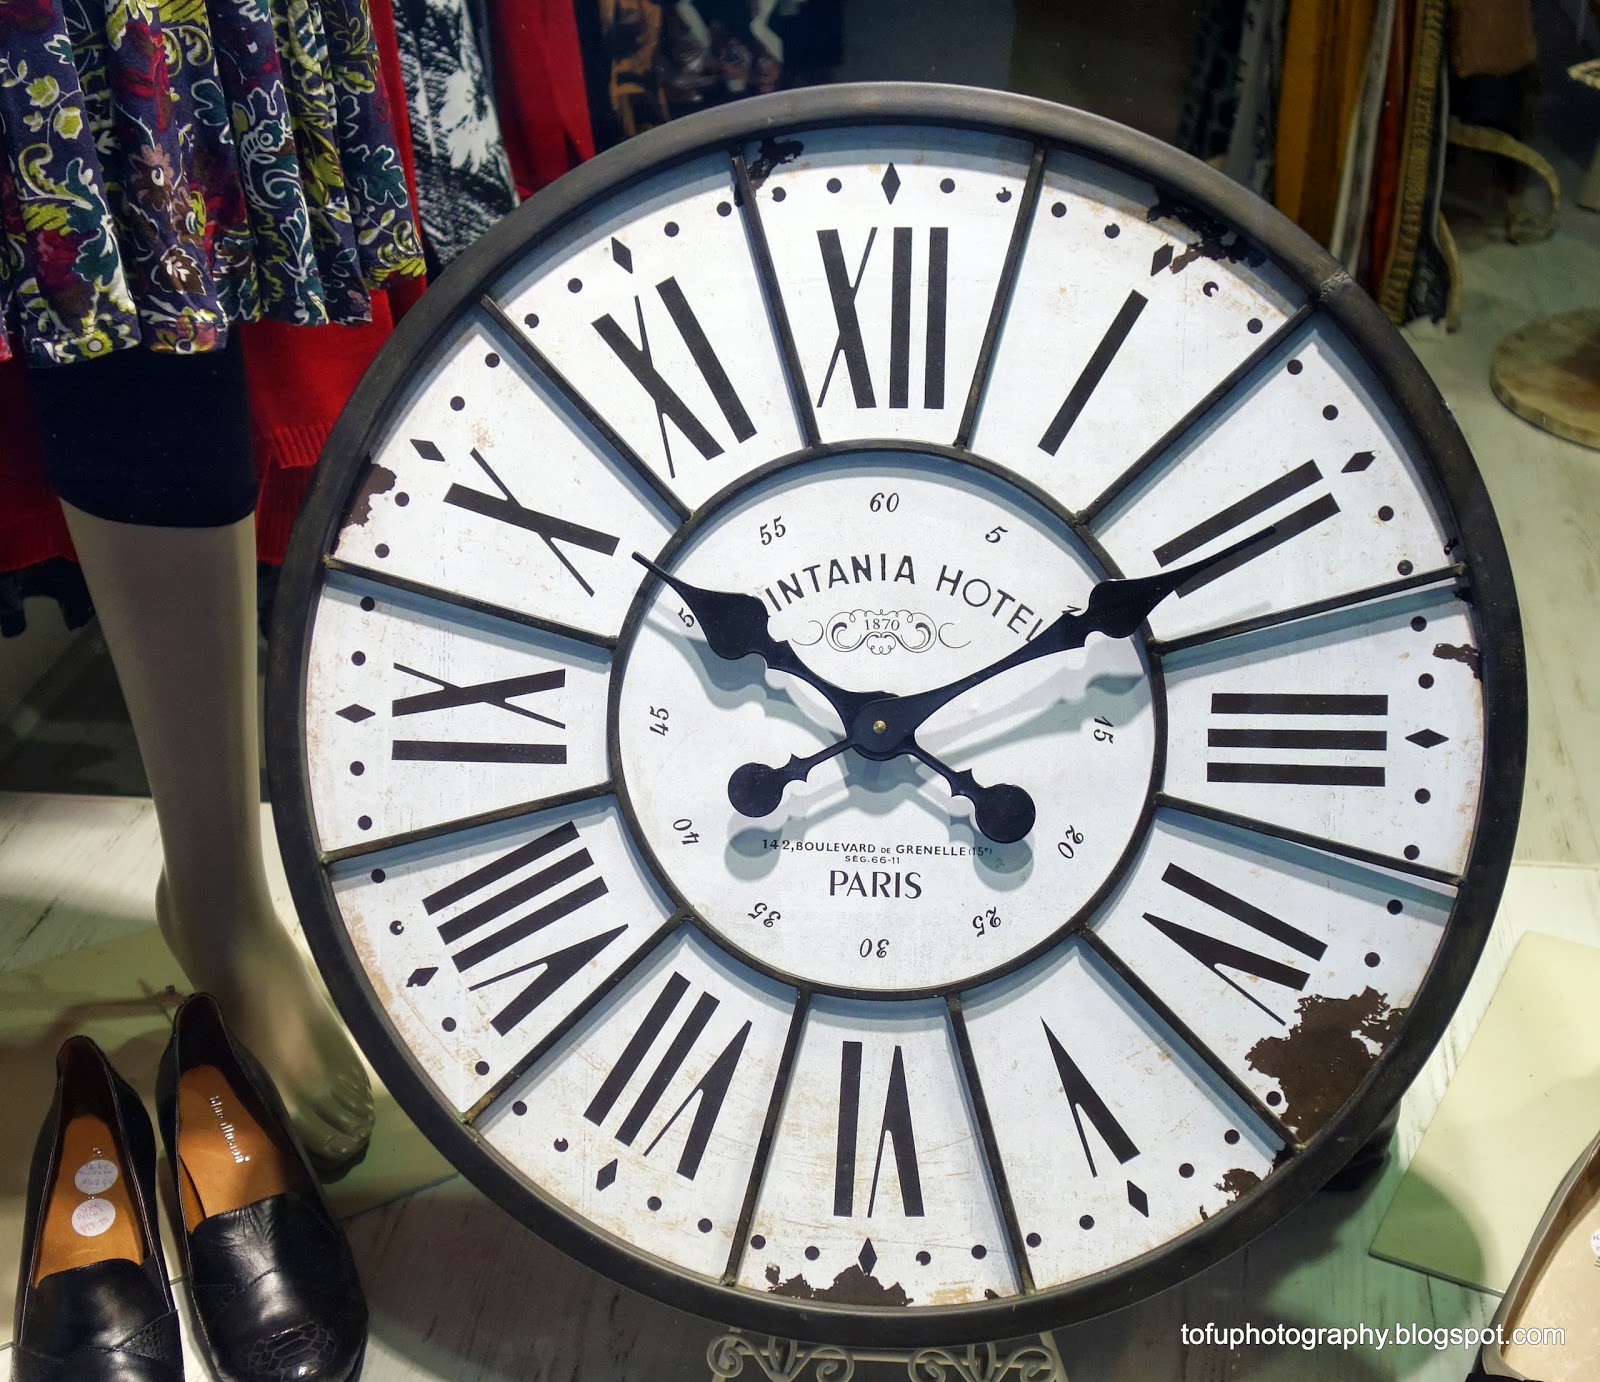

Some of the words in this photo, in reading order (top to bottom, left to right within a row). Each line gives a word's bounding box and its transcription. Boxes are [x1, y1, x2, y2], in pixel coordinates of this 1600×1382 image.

[816, 227, 949, 410] XII
[591, 276, 758, 479] XI
[1037, 289, 1149, 457] I
[443, 447, 620, 598] X
[759, 515, 787, 546] 55
[869, 492, 901, 513] 60
[984, 525, 1009, 544] 5
[764, 552, 916, 617] INTANIA
[935, 564, 1044, 642] HOTEL
[864, 618, 900, 631] 1870
[391, 662, 567, 765] IX
[648, 706, 669, 737] 45
[1093, 715, 1114, 745] 15
[1206, 692, 1389, 788] III
[672, 818, 700, 845] 40
[1057, 824, 1084, 859] 20
[747, 902, 781, 928] 35
[829, 869, 923, 899] PARIS
[421, 819, 629, 1037] VIII
[859, 938, 890, 959] 30
[972, 906, 1002, 938] 25
[1141, 862, 1329, 1026] IV
[583, 971, 753, 1181] VII
[1041, 1016, 1141, 1178] V
[833, 1040, 925, 1218] VI
